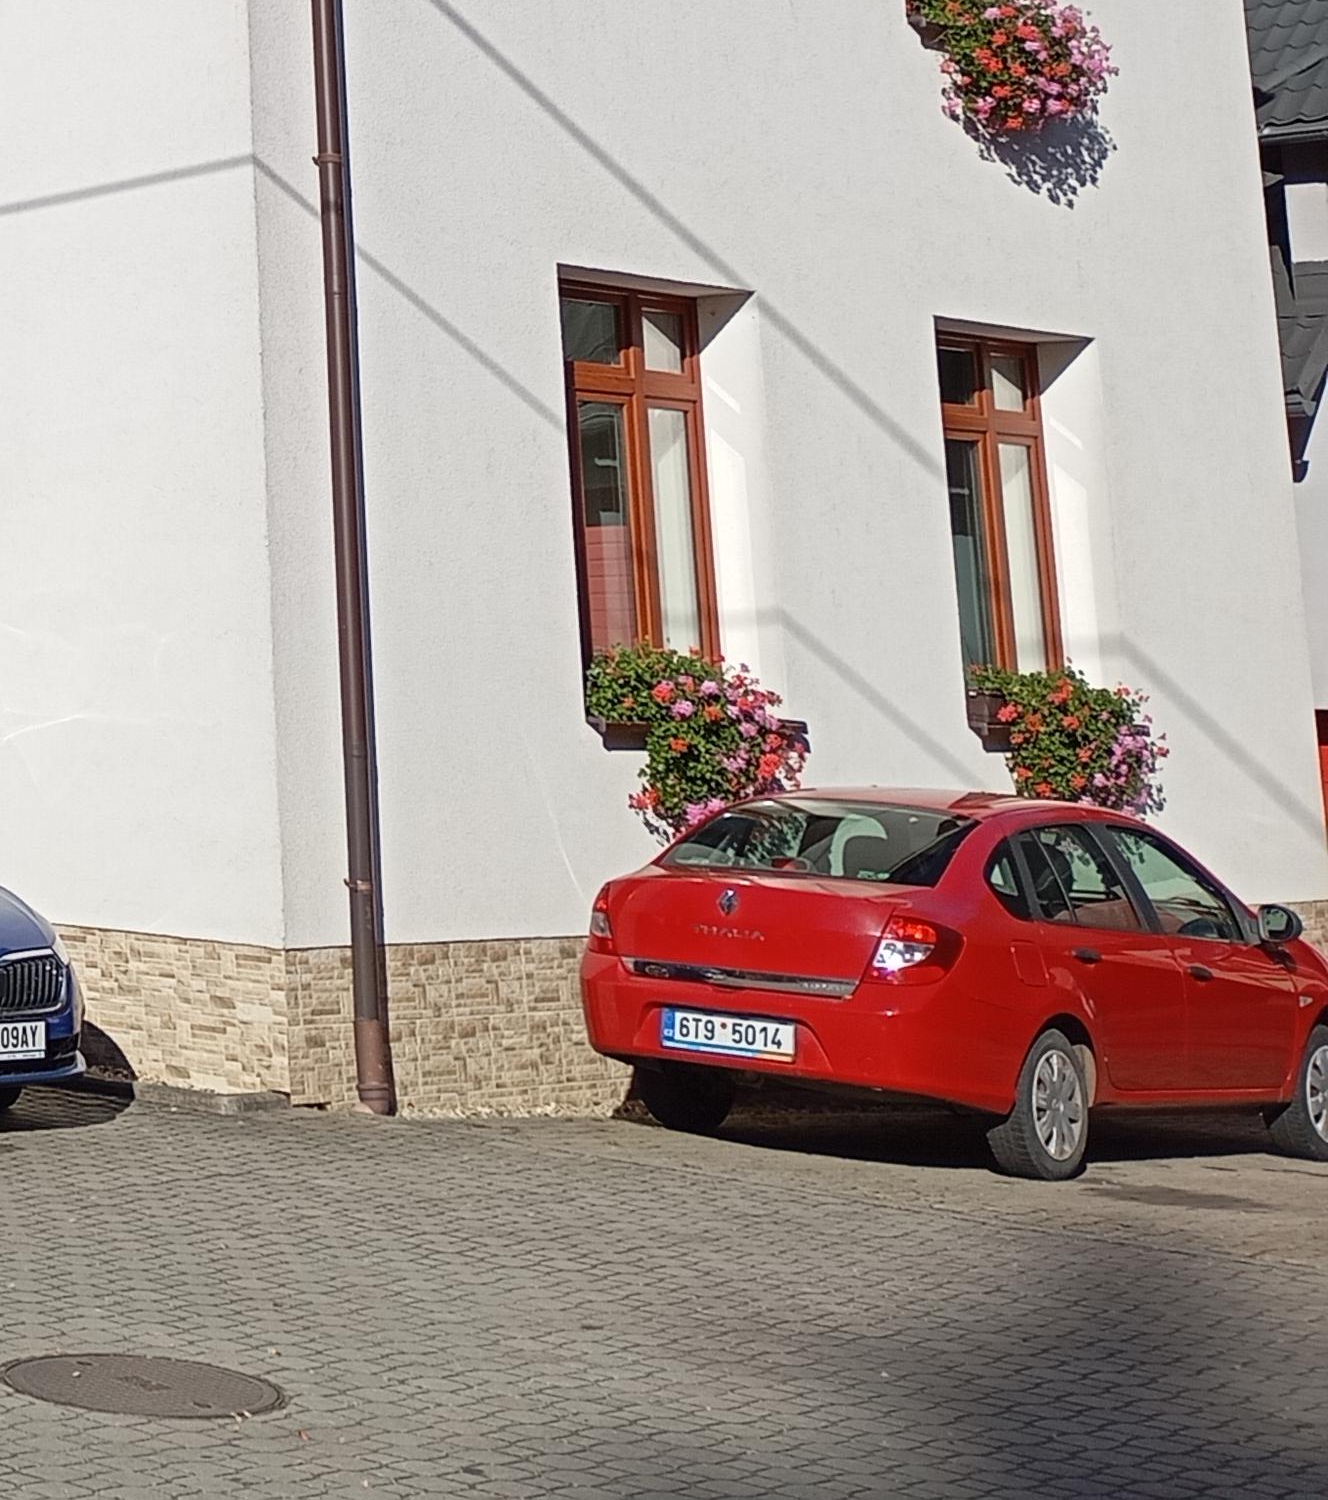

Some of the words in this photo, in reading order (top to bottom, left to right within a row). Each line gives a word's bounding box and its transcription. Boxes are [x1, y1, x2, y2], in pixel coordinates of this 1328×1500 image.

[0, 1024, 38, 1049] 09AY
[679, 1016, 715, 1041] 6T9
[731, 1022, 782, 1050] 5014
